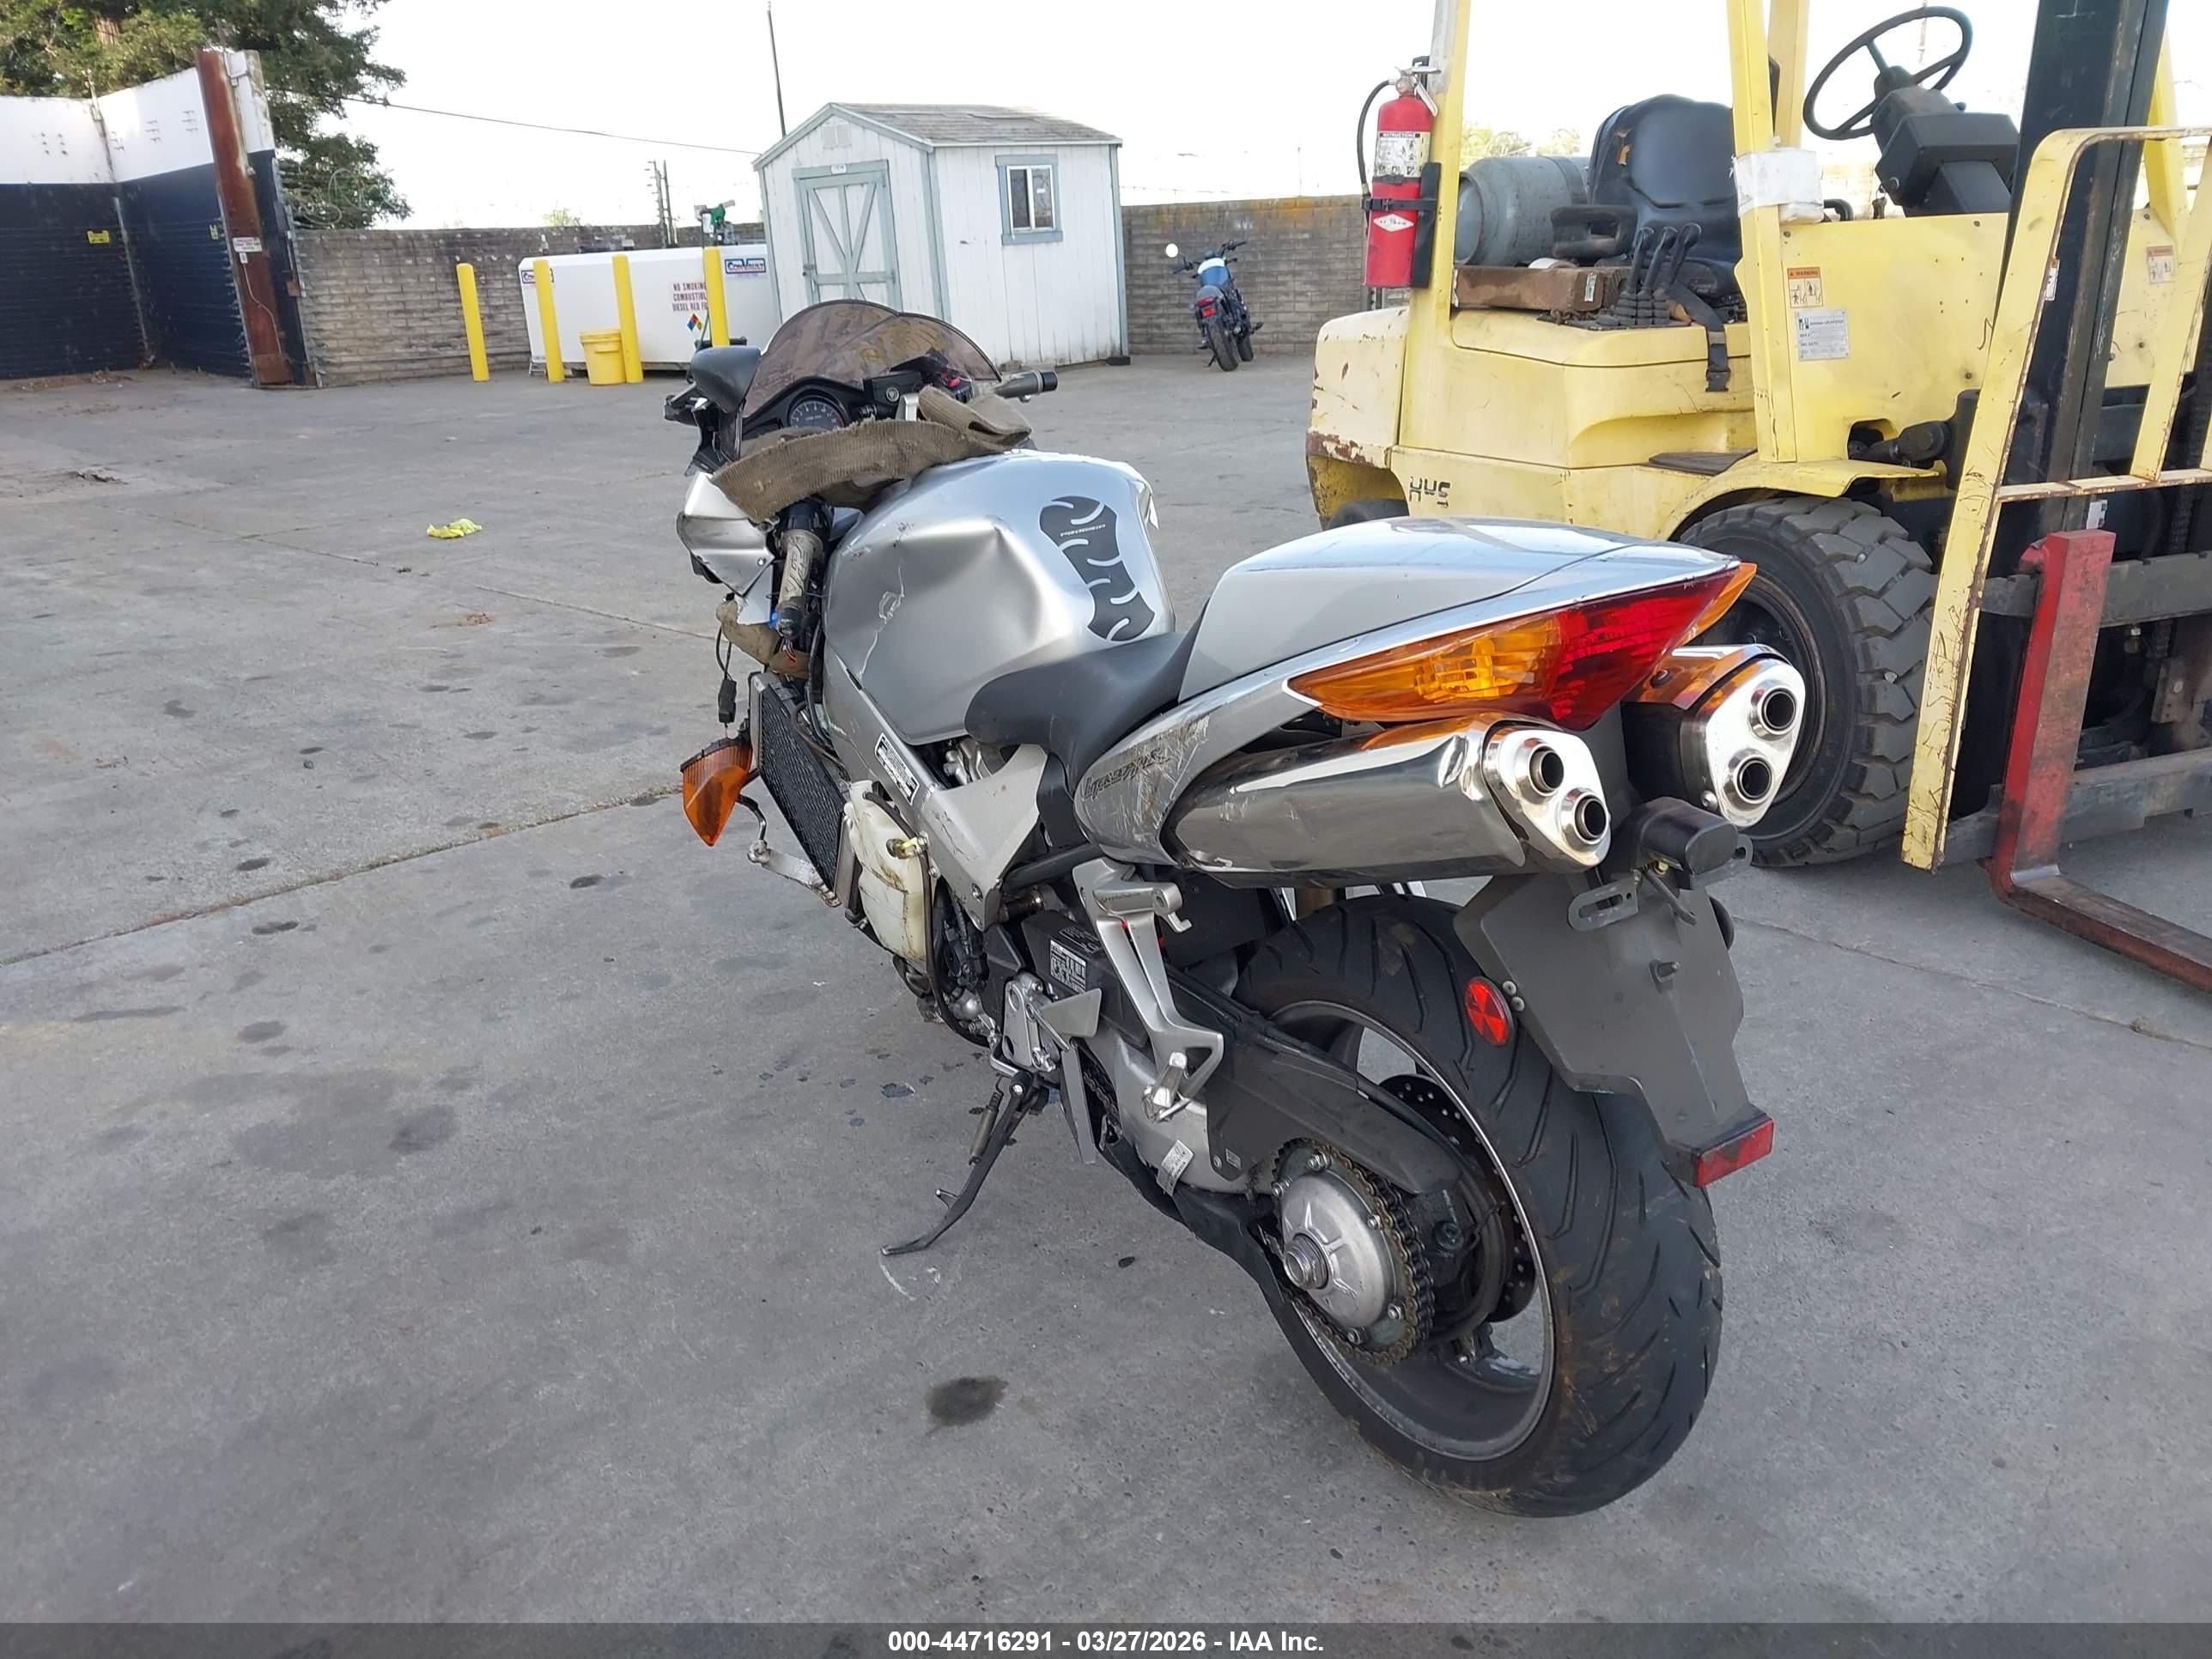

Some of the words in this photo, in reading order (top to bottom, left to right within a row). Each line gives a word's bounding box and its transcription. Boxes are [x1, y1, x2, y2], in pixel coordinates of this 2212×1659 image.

[673, 283, 681, 291] NO
[673, 292, 708, 301] COMBUSTIBL
[672, 303, 689, 312] DIESEL
[690, 302, 700, 311] RED
